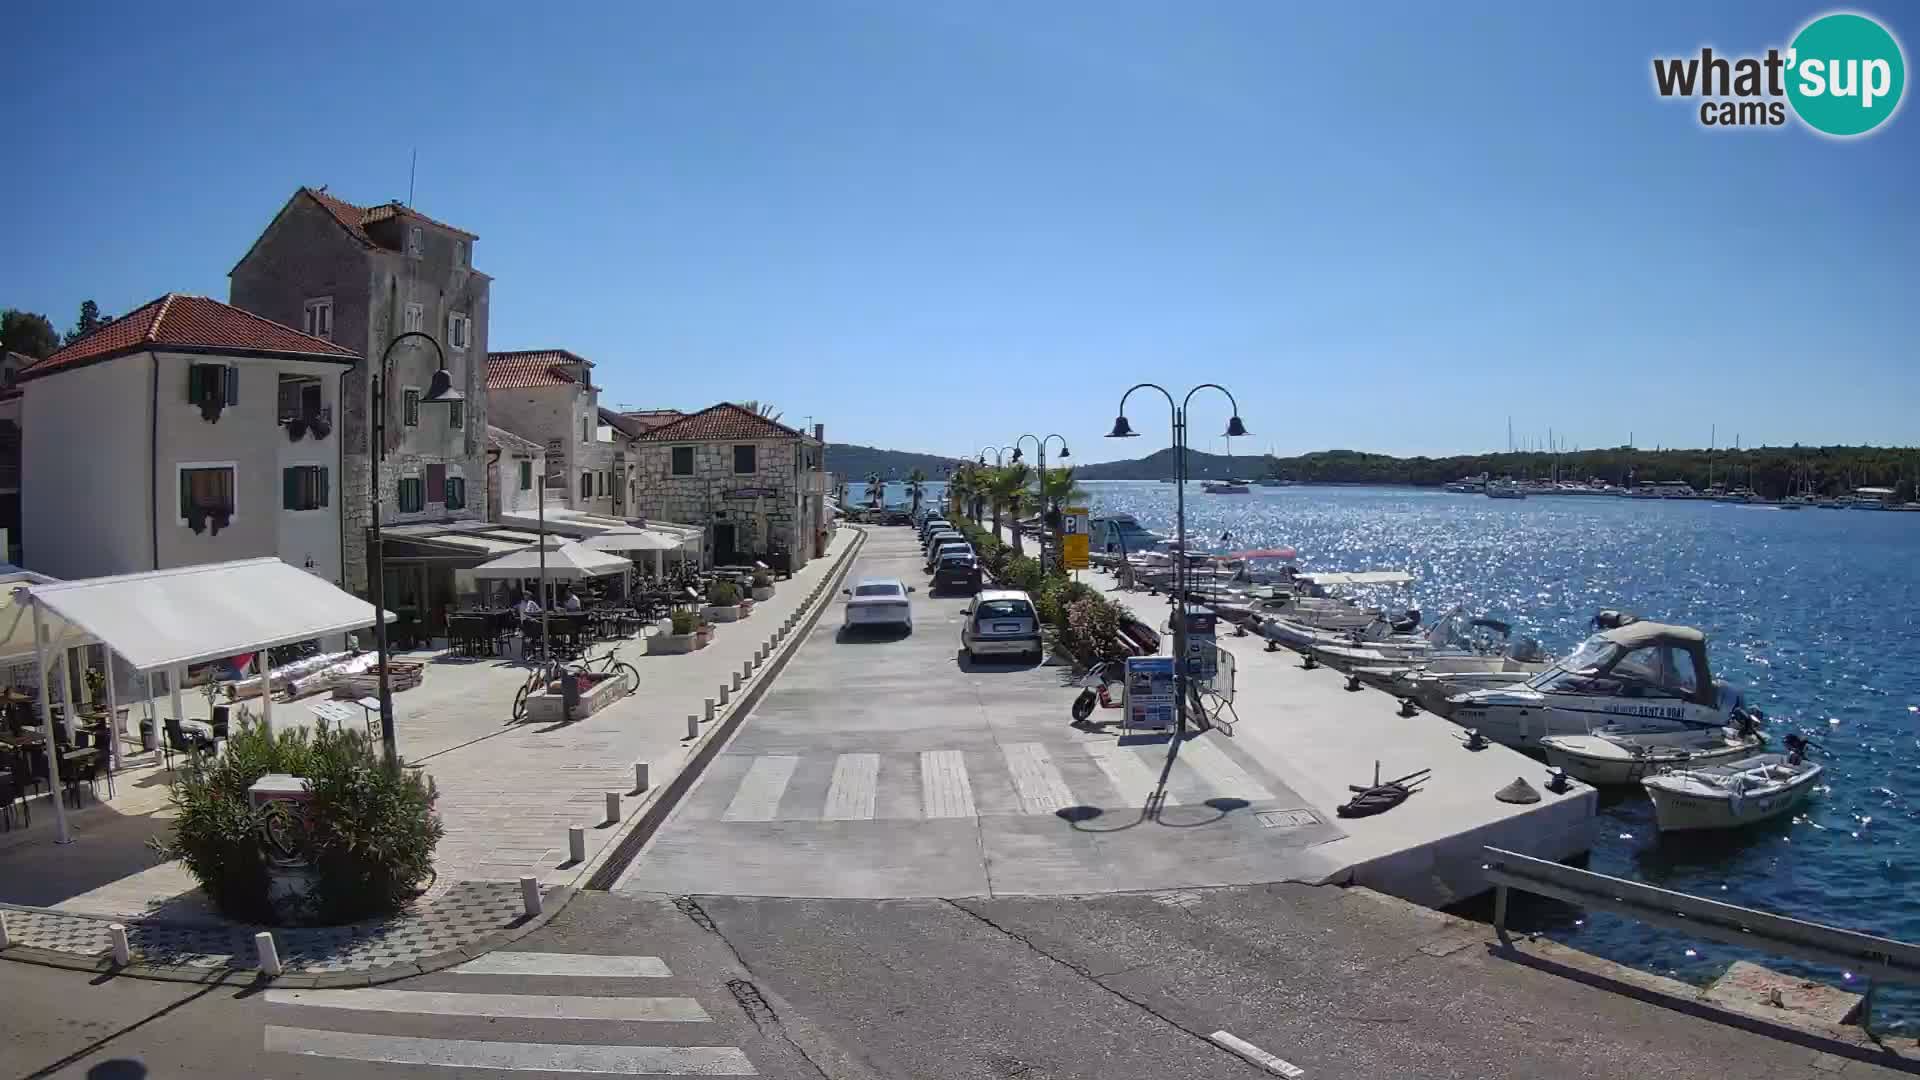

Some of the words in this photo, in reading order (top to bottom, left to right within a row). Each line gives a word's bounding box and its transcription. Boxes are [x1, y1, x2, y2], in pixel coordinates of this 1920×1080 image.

[1065, 516, 1076, 532] P
[1639, 706, 1658, 718] RENT
[1667, 707, 1685, 720] BOAT
